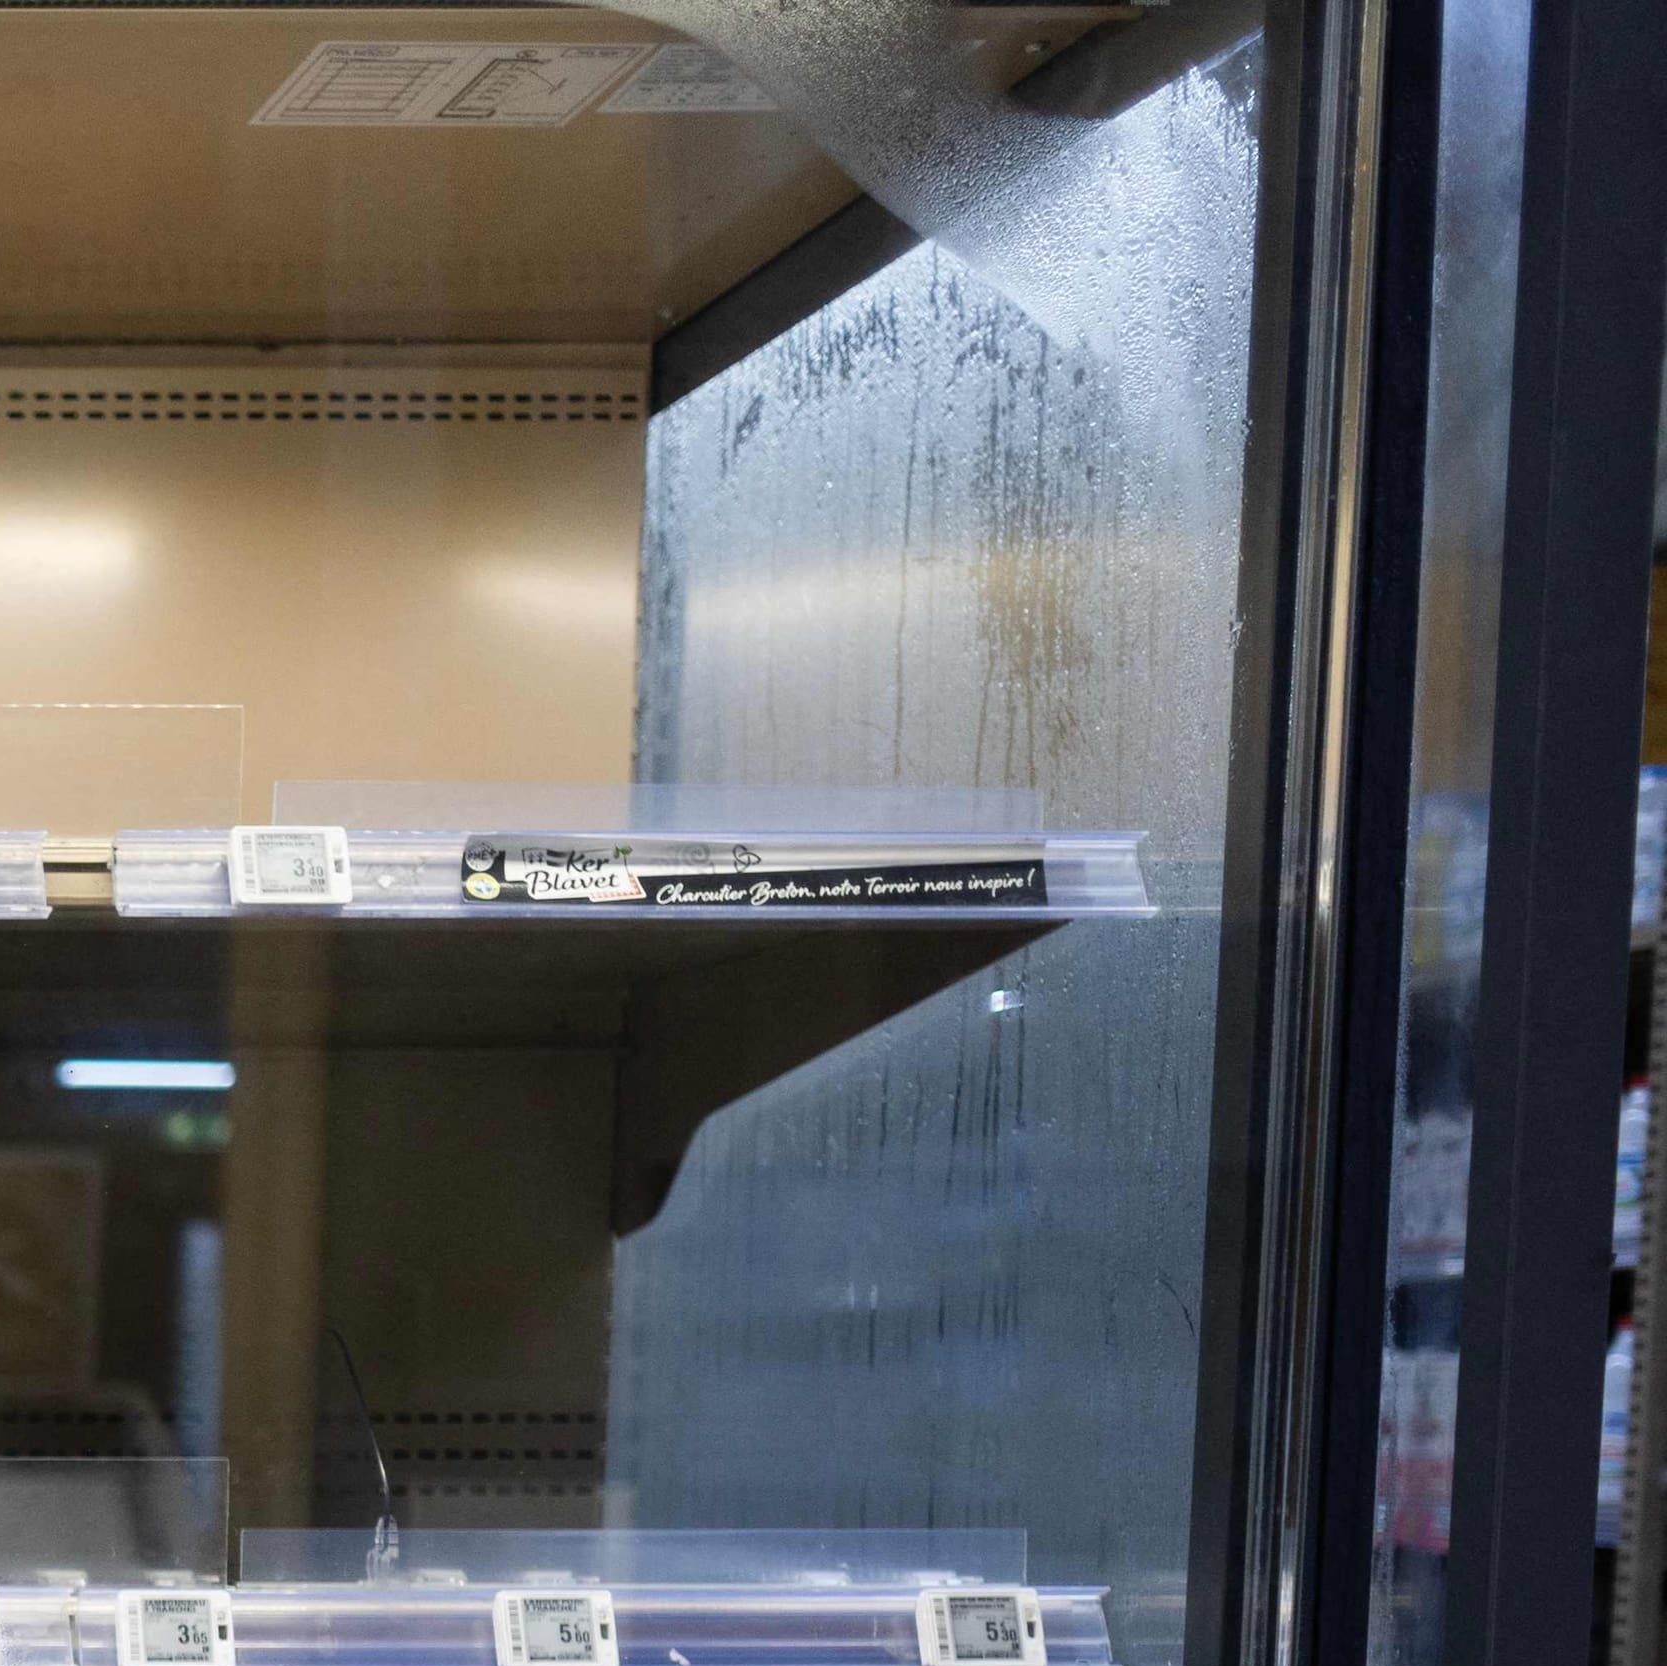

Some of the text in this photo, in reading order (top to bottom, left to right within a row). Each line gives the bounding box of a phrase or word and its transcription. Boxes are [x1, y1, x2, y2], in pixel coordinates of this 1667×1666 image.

[567, 849, 610, 873] Ker
[525, 870, 619, 895] Blavet
[656, 882, 747, 905] Charcutier
[819, 879, 861, 897] notre
[865, 876, 920, 897] Terroir
[924, 881, 963, 892] nous
